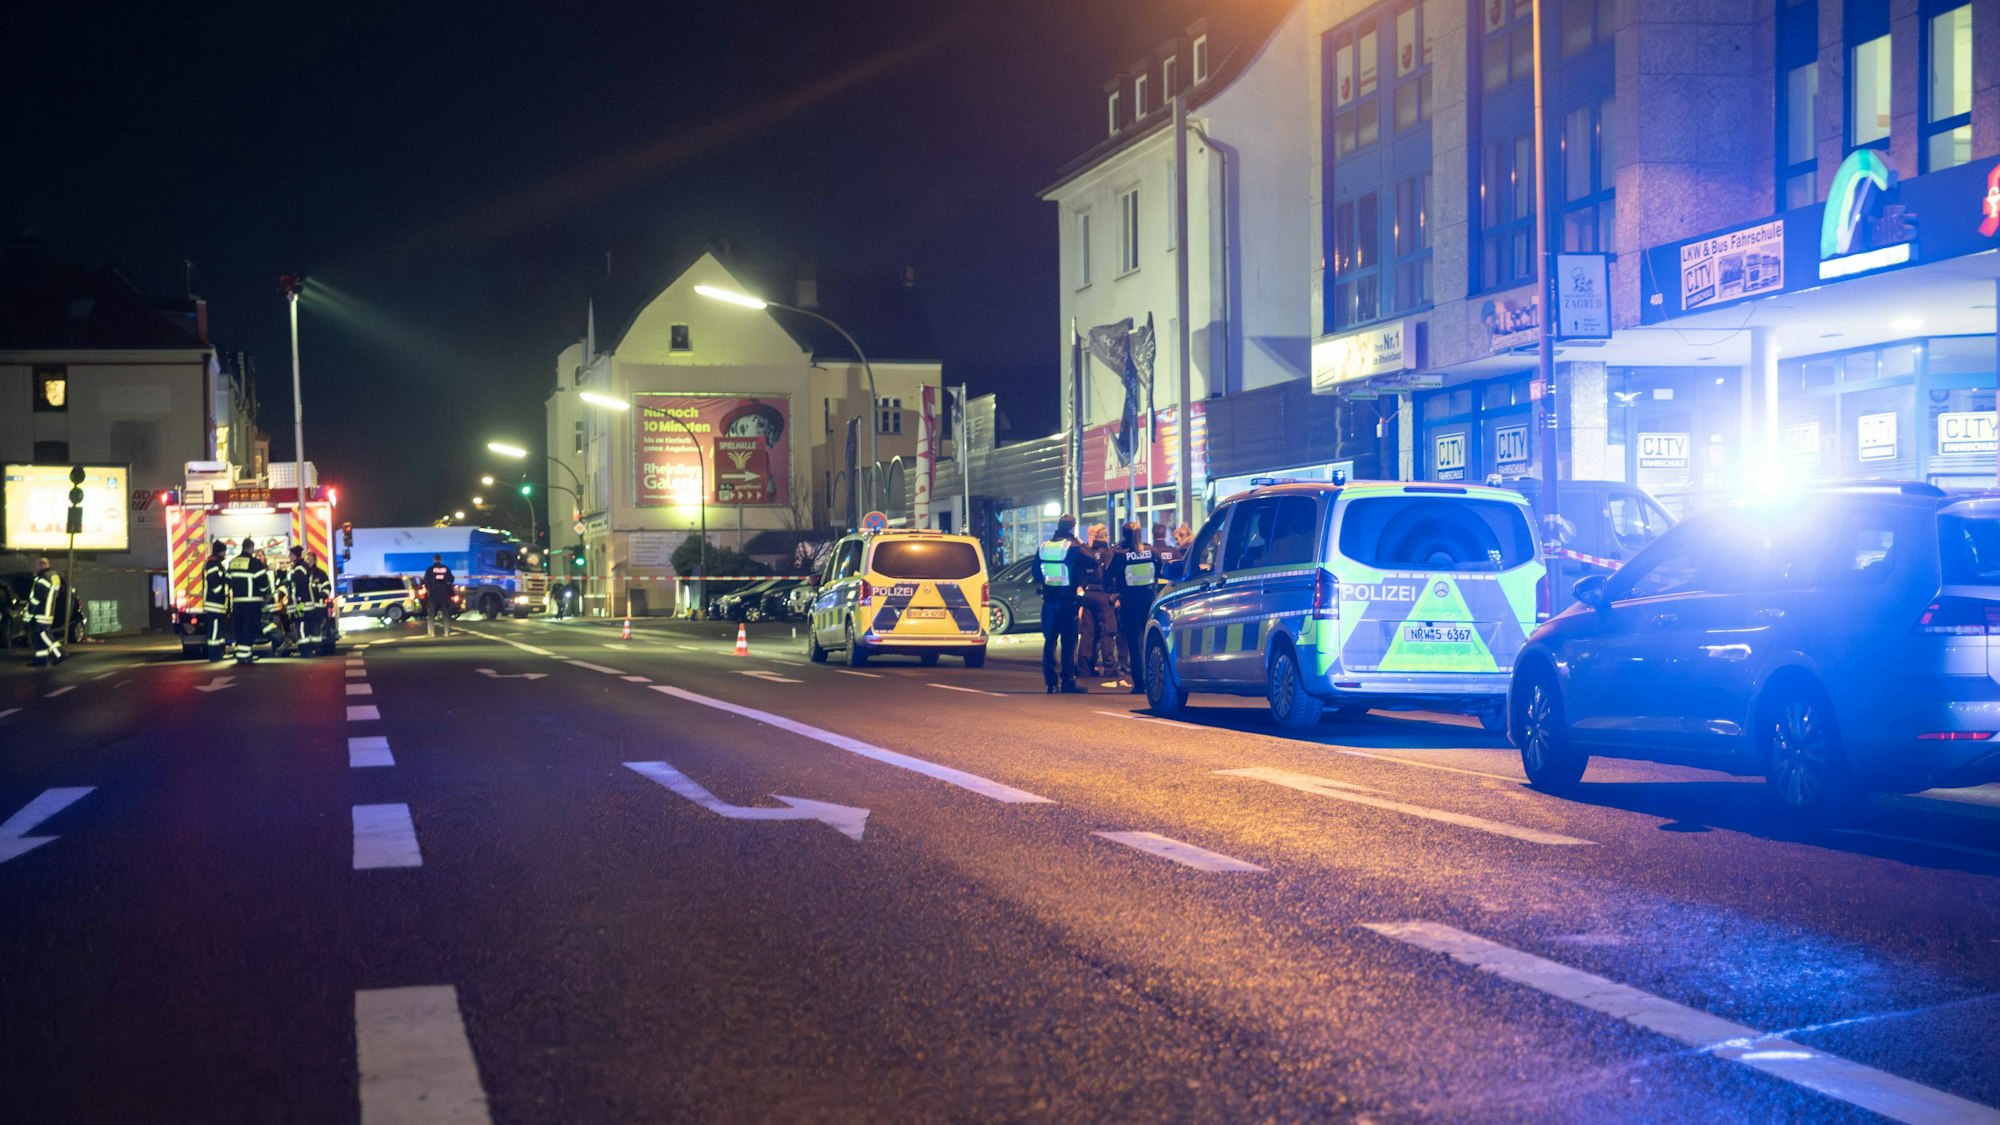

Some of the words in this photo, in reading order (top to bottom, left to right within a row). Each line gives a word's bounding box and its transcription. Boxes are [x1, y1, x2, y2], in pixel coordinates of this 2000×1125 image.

[1683, 245, 1701, 262] LKW
[1703, 242, 1710, 257] &
[1712, 238, 1728, 255] Bus
[1731, 223, 1782, 248] Fahrschule
[1686, 261, 1713, 294] CITY
[1564, 298, 1602, 309] ZAGREB
[644, 407, 666, 418] Nur
[668, 407, 699, 418] noch
[644, 421, 658, 432] 10
[659, 421, 711, 432] Minuten
[1946, 418, 1998, 438] CITY
[719, 441, 756, 450] SPIELHALLE
[1498, 431, 1526, 459] CITY
[1643, 438, 1685, 456] CITY
[1439, 440, 1463, 466] CITY
[1498, 462, 1526, 475] FAHRSCHULE
[1642, 459, 1686, 467] FAHRSCHULE
[1438, 469, 1464, 480] FAHRSCHULE
[872, 587, 914, 597] POLIZEI
[1341, 584, 1416, 601] POLIZEI
[1411, 629, 1430, 640] NRW
